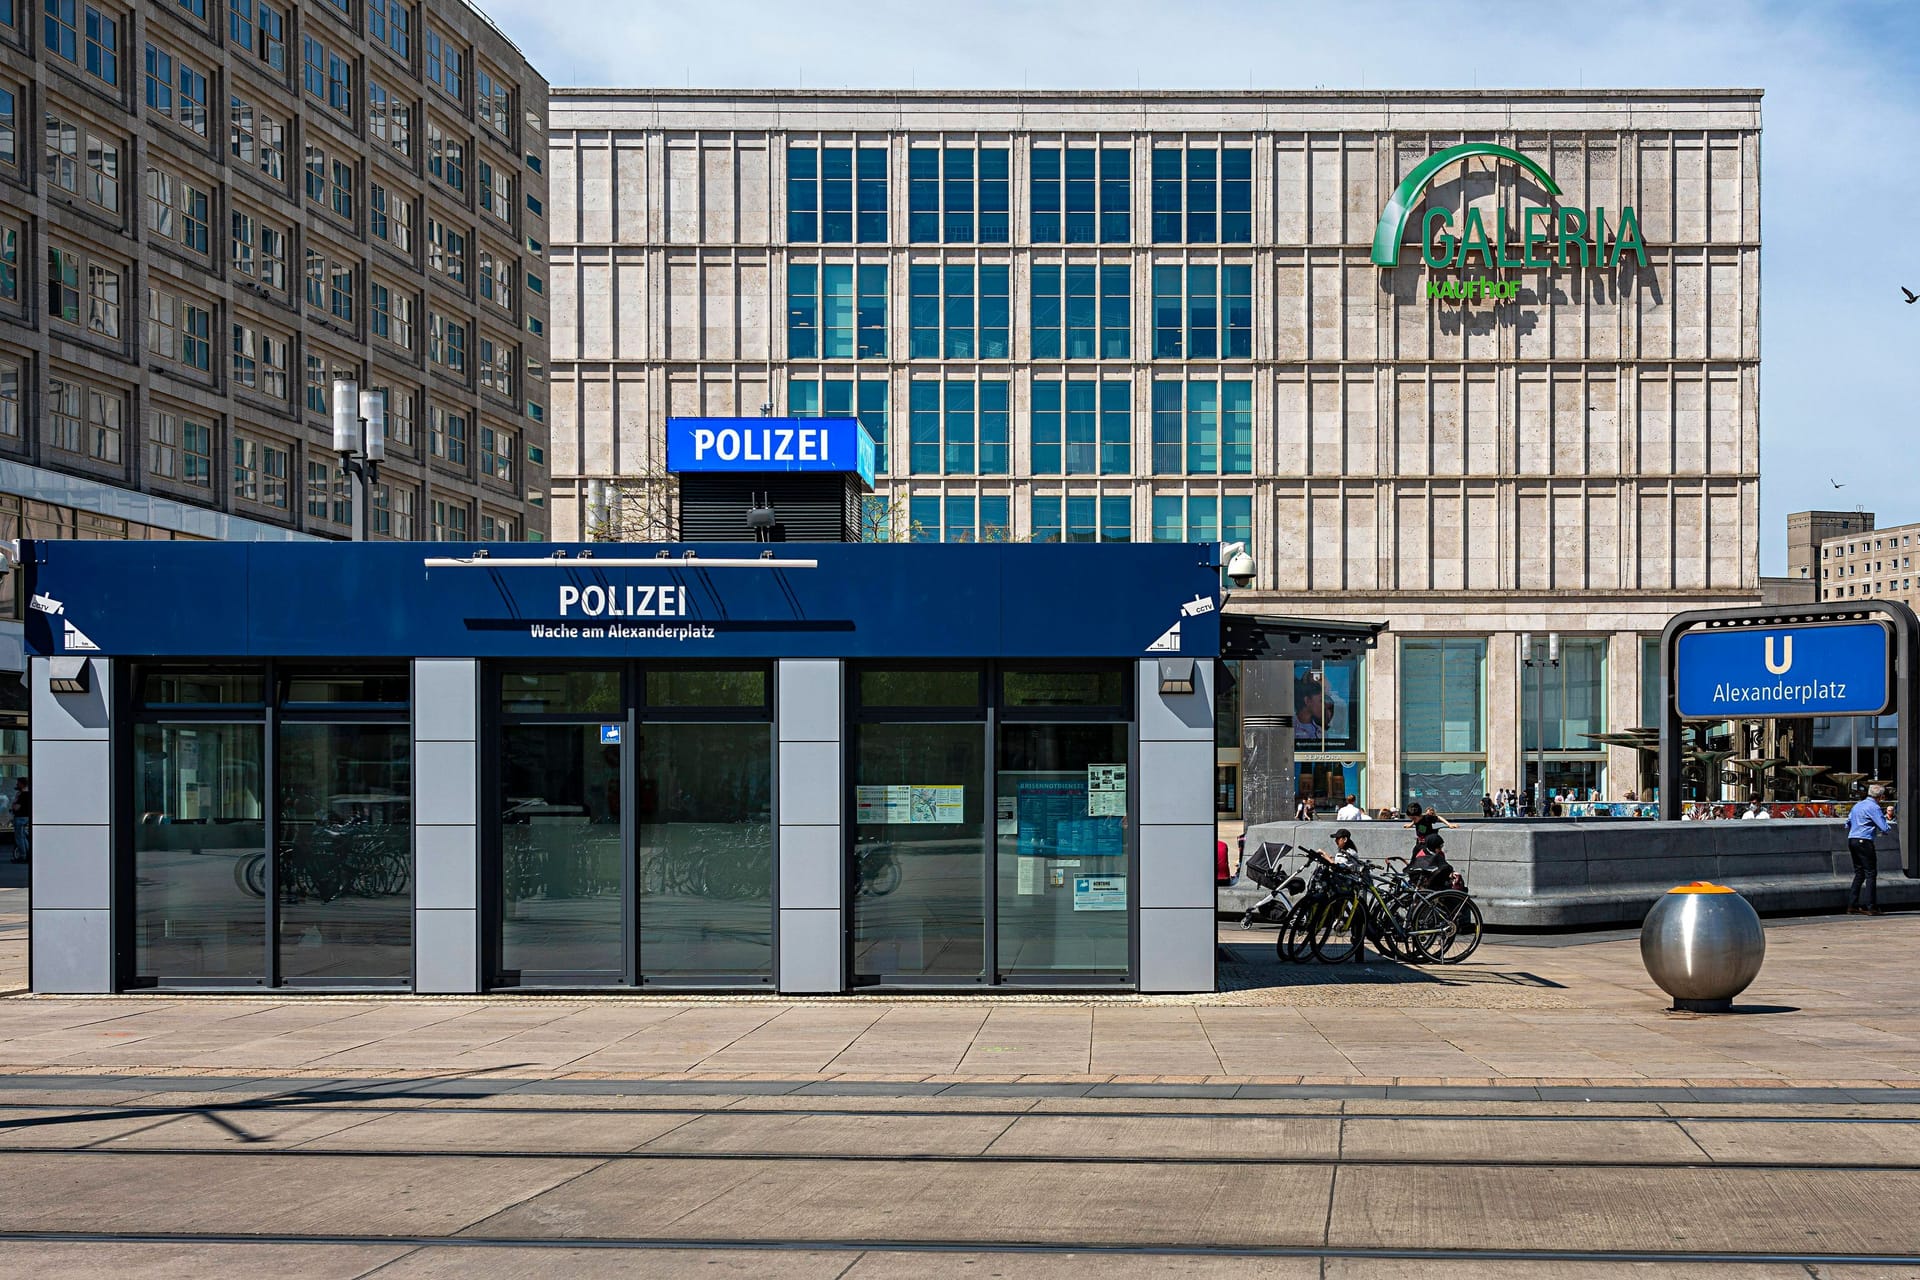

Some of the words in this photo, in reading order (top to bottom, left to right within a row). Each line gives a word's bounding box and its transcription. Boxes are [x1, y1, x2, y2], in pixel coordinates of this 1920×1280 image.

[1422, 206, 1647, 268] GALERIA
[694, 428, 829, 461] POLIZEI
[559, 585, 686, 616] POLIZEI
[1195, 604, 1213, 613] CCTV
[531, 624, 579, 639] Wache
[582, 628, 605, 639] am
[608, 624, 715, 642] Alexanderplatz
[1764, 635, 1793, 675] U
[1713, 679, 1847, 705] Alexanderplatz
